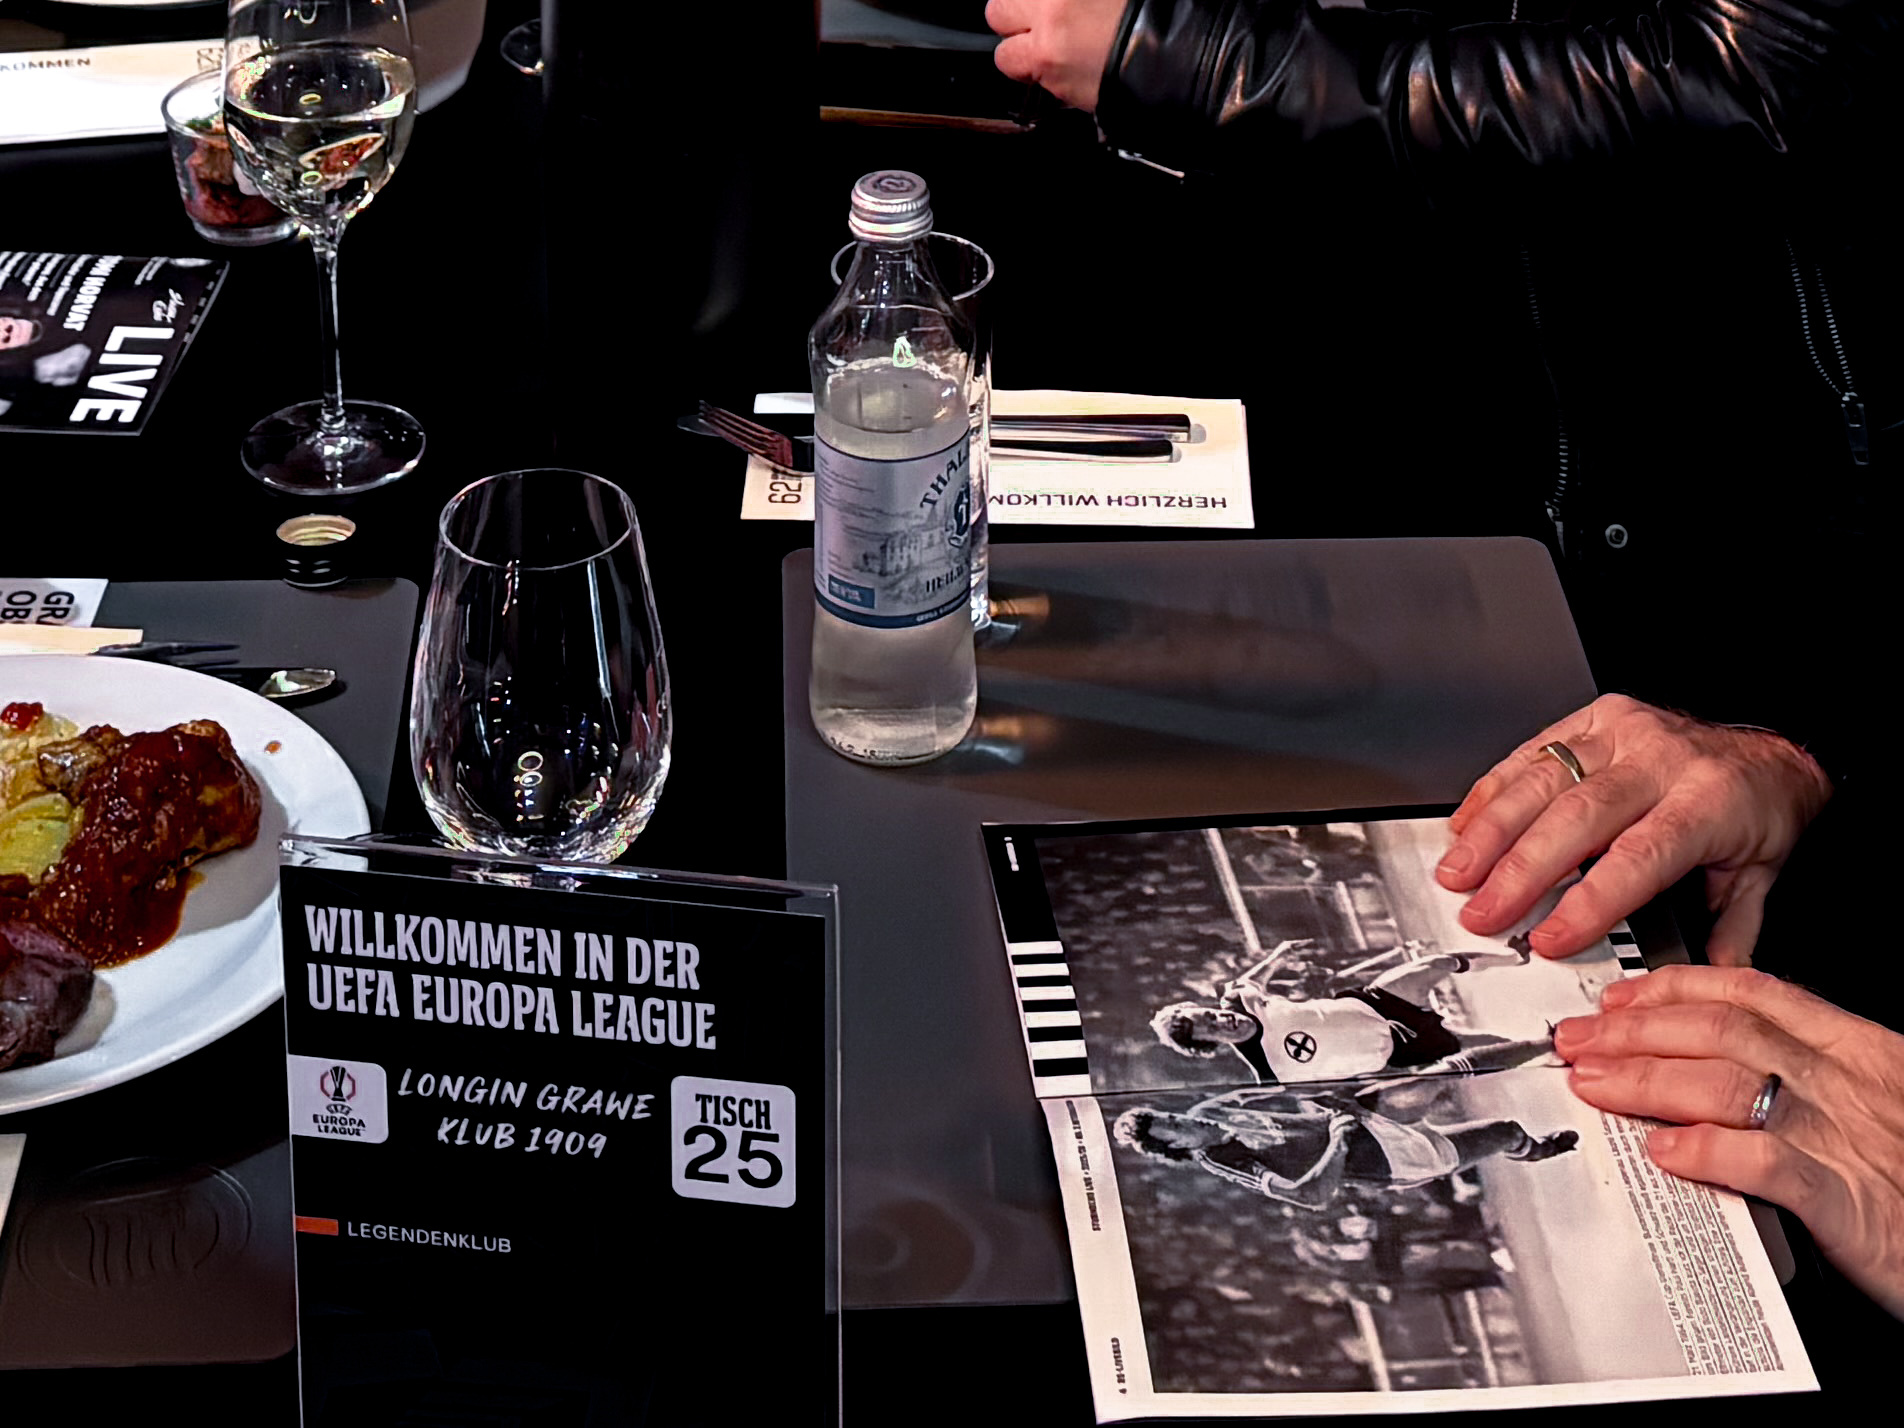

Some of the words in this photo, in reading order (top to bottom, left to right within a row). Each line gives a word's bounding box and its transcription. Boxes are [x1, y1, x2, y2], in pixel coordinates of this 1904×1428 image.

[69, 325, 176, 424] LIVE
[767, 481, 802, 505] 62
[988, 493, 1099, 508] WILLKOM
[1106, 494, 1227, 509] HERZLICH
[305, 905, 561, 976] WILLKOMMEN
[575, 932, 613, 981] IN
[627, 937, 700, 989] DER
[307, 963, 400, 1017] UEFA
[412, 975, 559, 1034] EUROPA
[573, 991, 716, 1050] LEAGUE
[398, 1068, 526, 1108] LONGIN
[536, 1083, 655, 1120] GRAWE
[696, 1094, 771, 1130] TISCH
[313, 1114, 366, 1129] EUROPA
[318, 1125, 364, 1137] LEAGUE
[438, 1117, 515, 1150] KLUB
[528, 1126, 607, 1158] 1909
[684, 1125, 784, 1190] 25
[347, 1220, 512, 1253] LEGENDENKLUB
